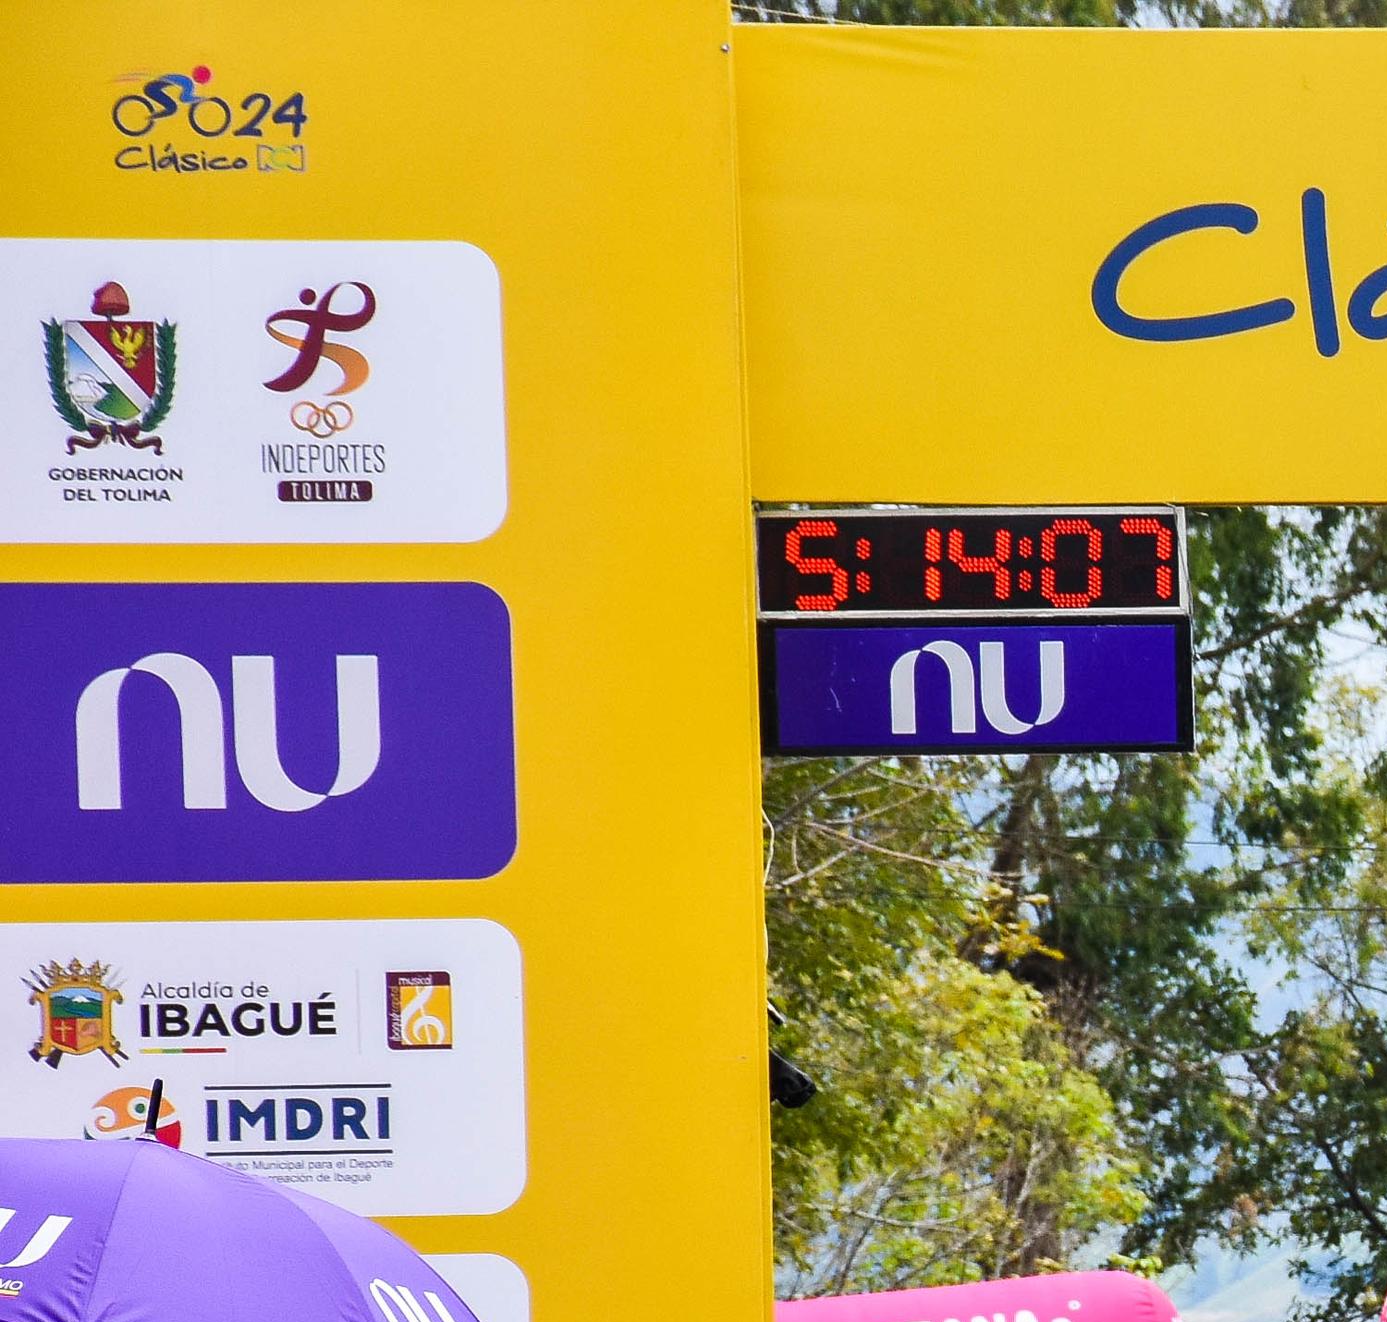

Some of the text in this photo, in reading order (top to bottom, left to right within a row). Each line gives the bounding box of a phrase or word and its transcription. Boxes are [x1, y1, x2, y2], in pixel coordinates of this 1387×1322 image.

[234, 93, 307, 137] 24
[115, 144, 248, 173] Clásico
[261, 443, 386, 474] INDEPORTES
[48, 463, 184, 482] GOBERNACIÓN
[63, 488, 171, 502] DEL TOLIMA
[290, 482, 361, 500] TOLIMA
[141, 981, 269, 999] Alcaldía de
[140, 993, 337, 1038] IBAGUÉ
[206, 1097, 390, 1142] IMDRI
[252, 1160, 304, 1172] Municipal
[308, 1161, 332, 1171] para
[336, 1160, 345, 1168] el
[350, 1158, 392, 1171] Deporte
[317, 1173, 330, 1182] de
